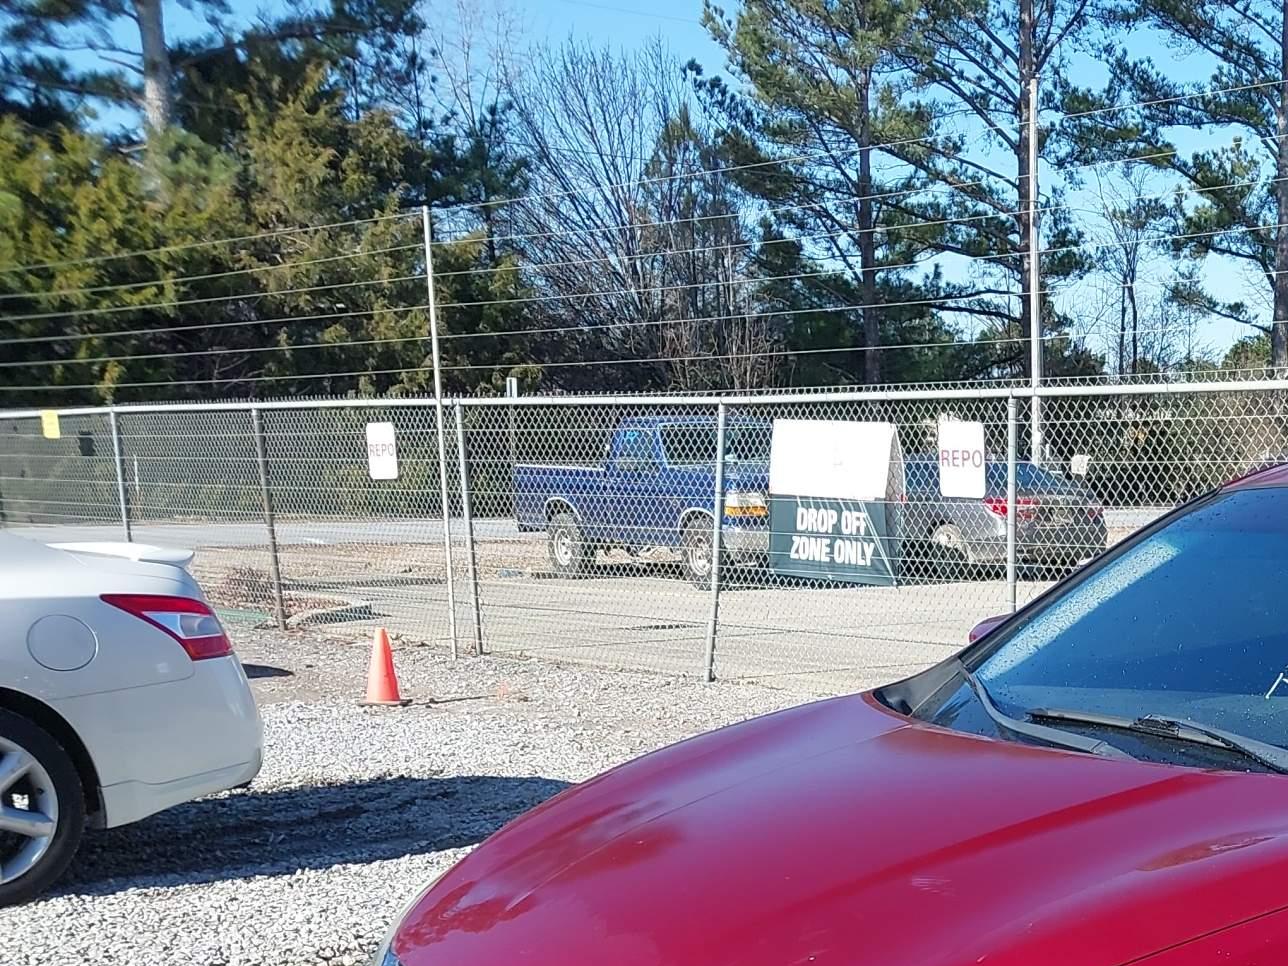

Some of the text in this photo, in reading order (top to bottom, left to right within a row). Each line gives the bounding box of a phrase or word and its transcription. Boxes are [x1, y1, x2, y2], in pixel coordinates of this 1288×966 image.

[369, 442, 395, 457] REPO
[941, 449, 983, 468] REPO
[796, 507, 868, 536] DROP OFF
[789, 536, 876, 567] ZONE ONLY
